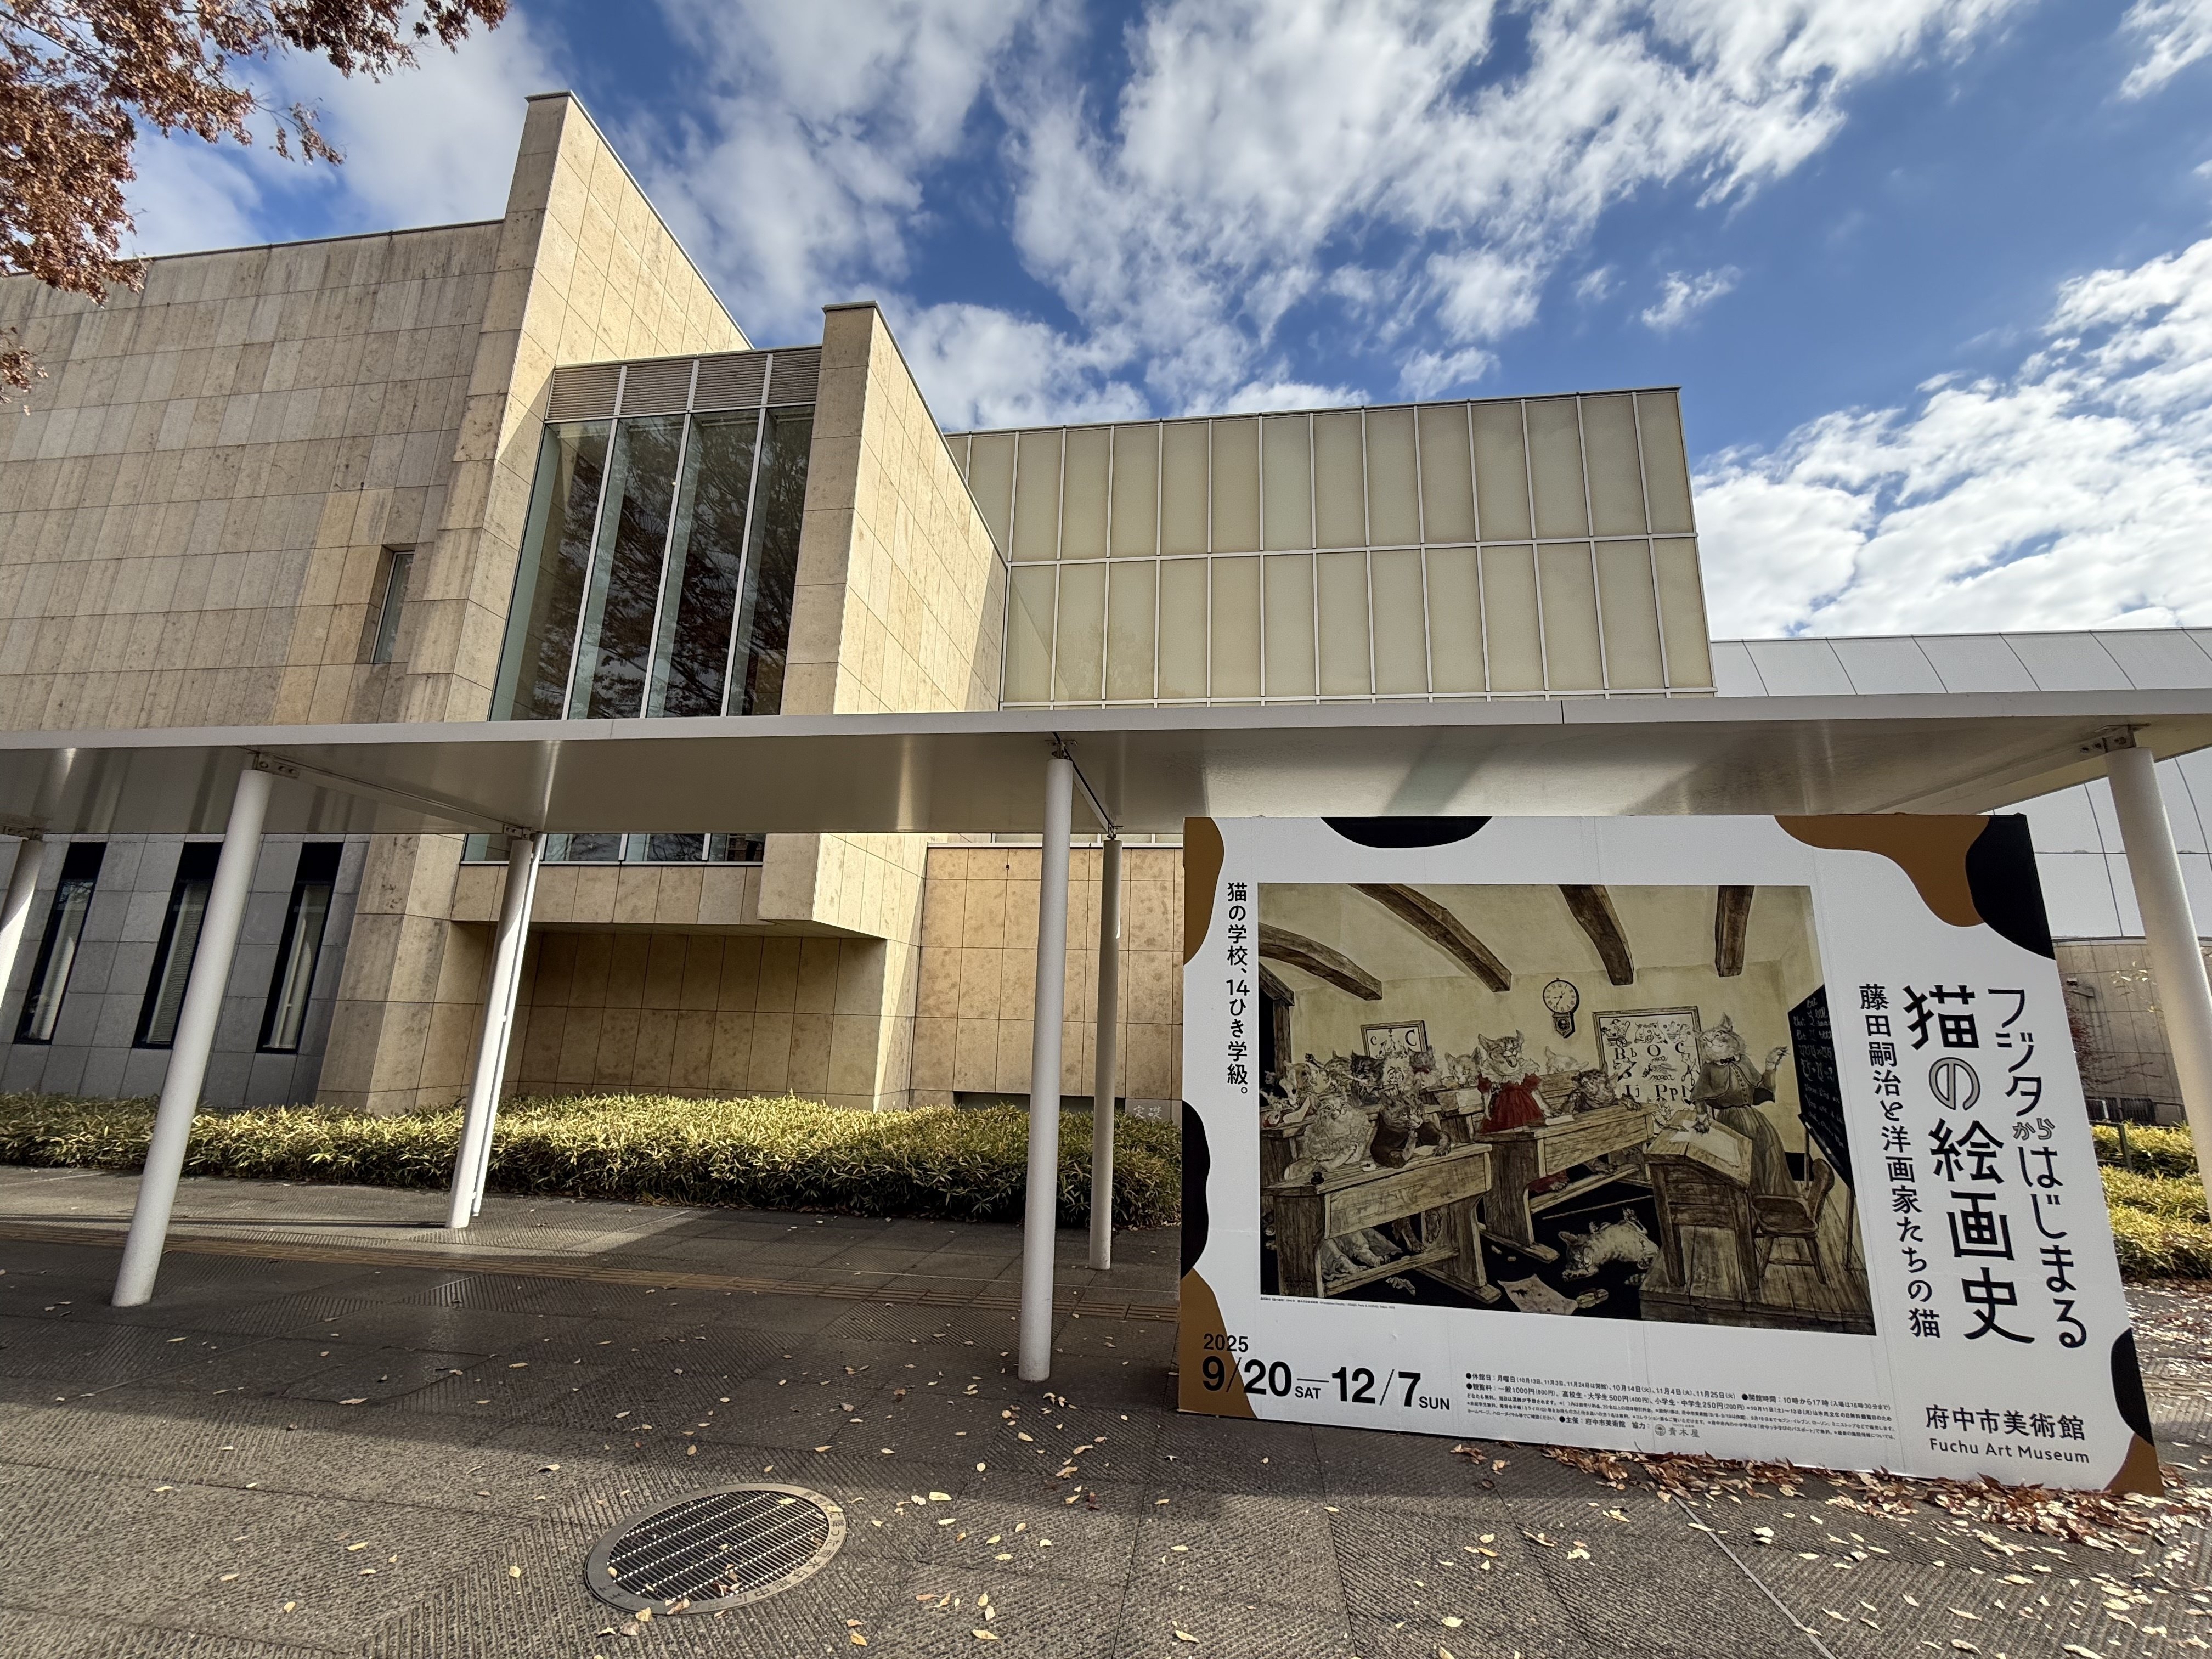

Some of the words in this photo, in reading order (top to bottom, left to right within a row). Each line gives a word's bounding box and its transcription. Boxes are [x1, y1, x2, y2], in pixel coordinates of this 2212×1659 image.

[1226, 882, 1250, 1094] 猫の学校、14ひき学級。
[1859, 984, 1940, 1338] 藤田嗣治と洋画家たちの猫
[1902, 985, 2035, 1344] 猫の絵画史
[1988, 988, 2087, 1348] フジタからはじまる
[1203, 1333, 1249, 1352] 2025
[1294, 1386, 1321, 1400] SAT
[1419, 1396, 1450, 1410] SUN
[1926, 1404, 2085, 1440] 府中市美術館
[1929, 1437, 1979, 1454] Fuchu
[1985, 1443, 2012, 1457] Art
[2018, 1445, 2090, 1464] Museum
